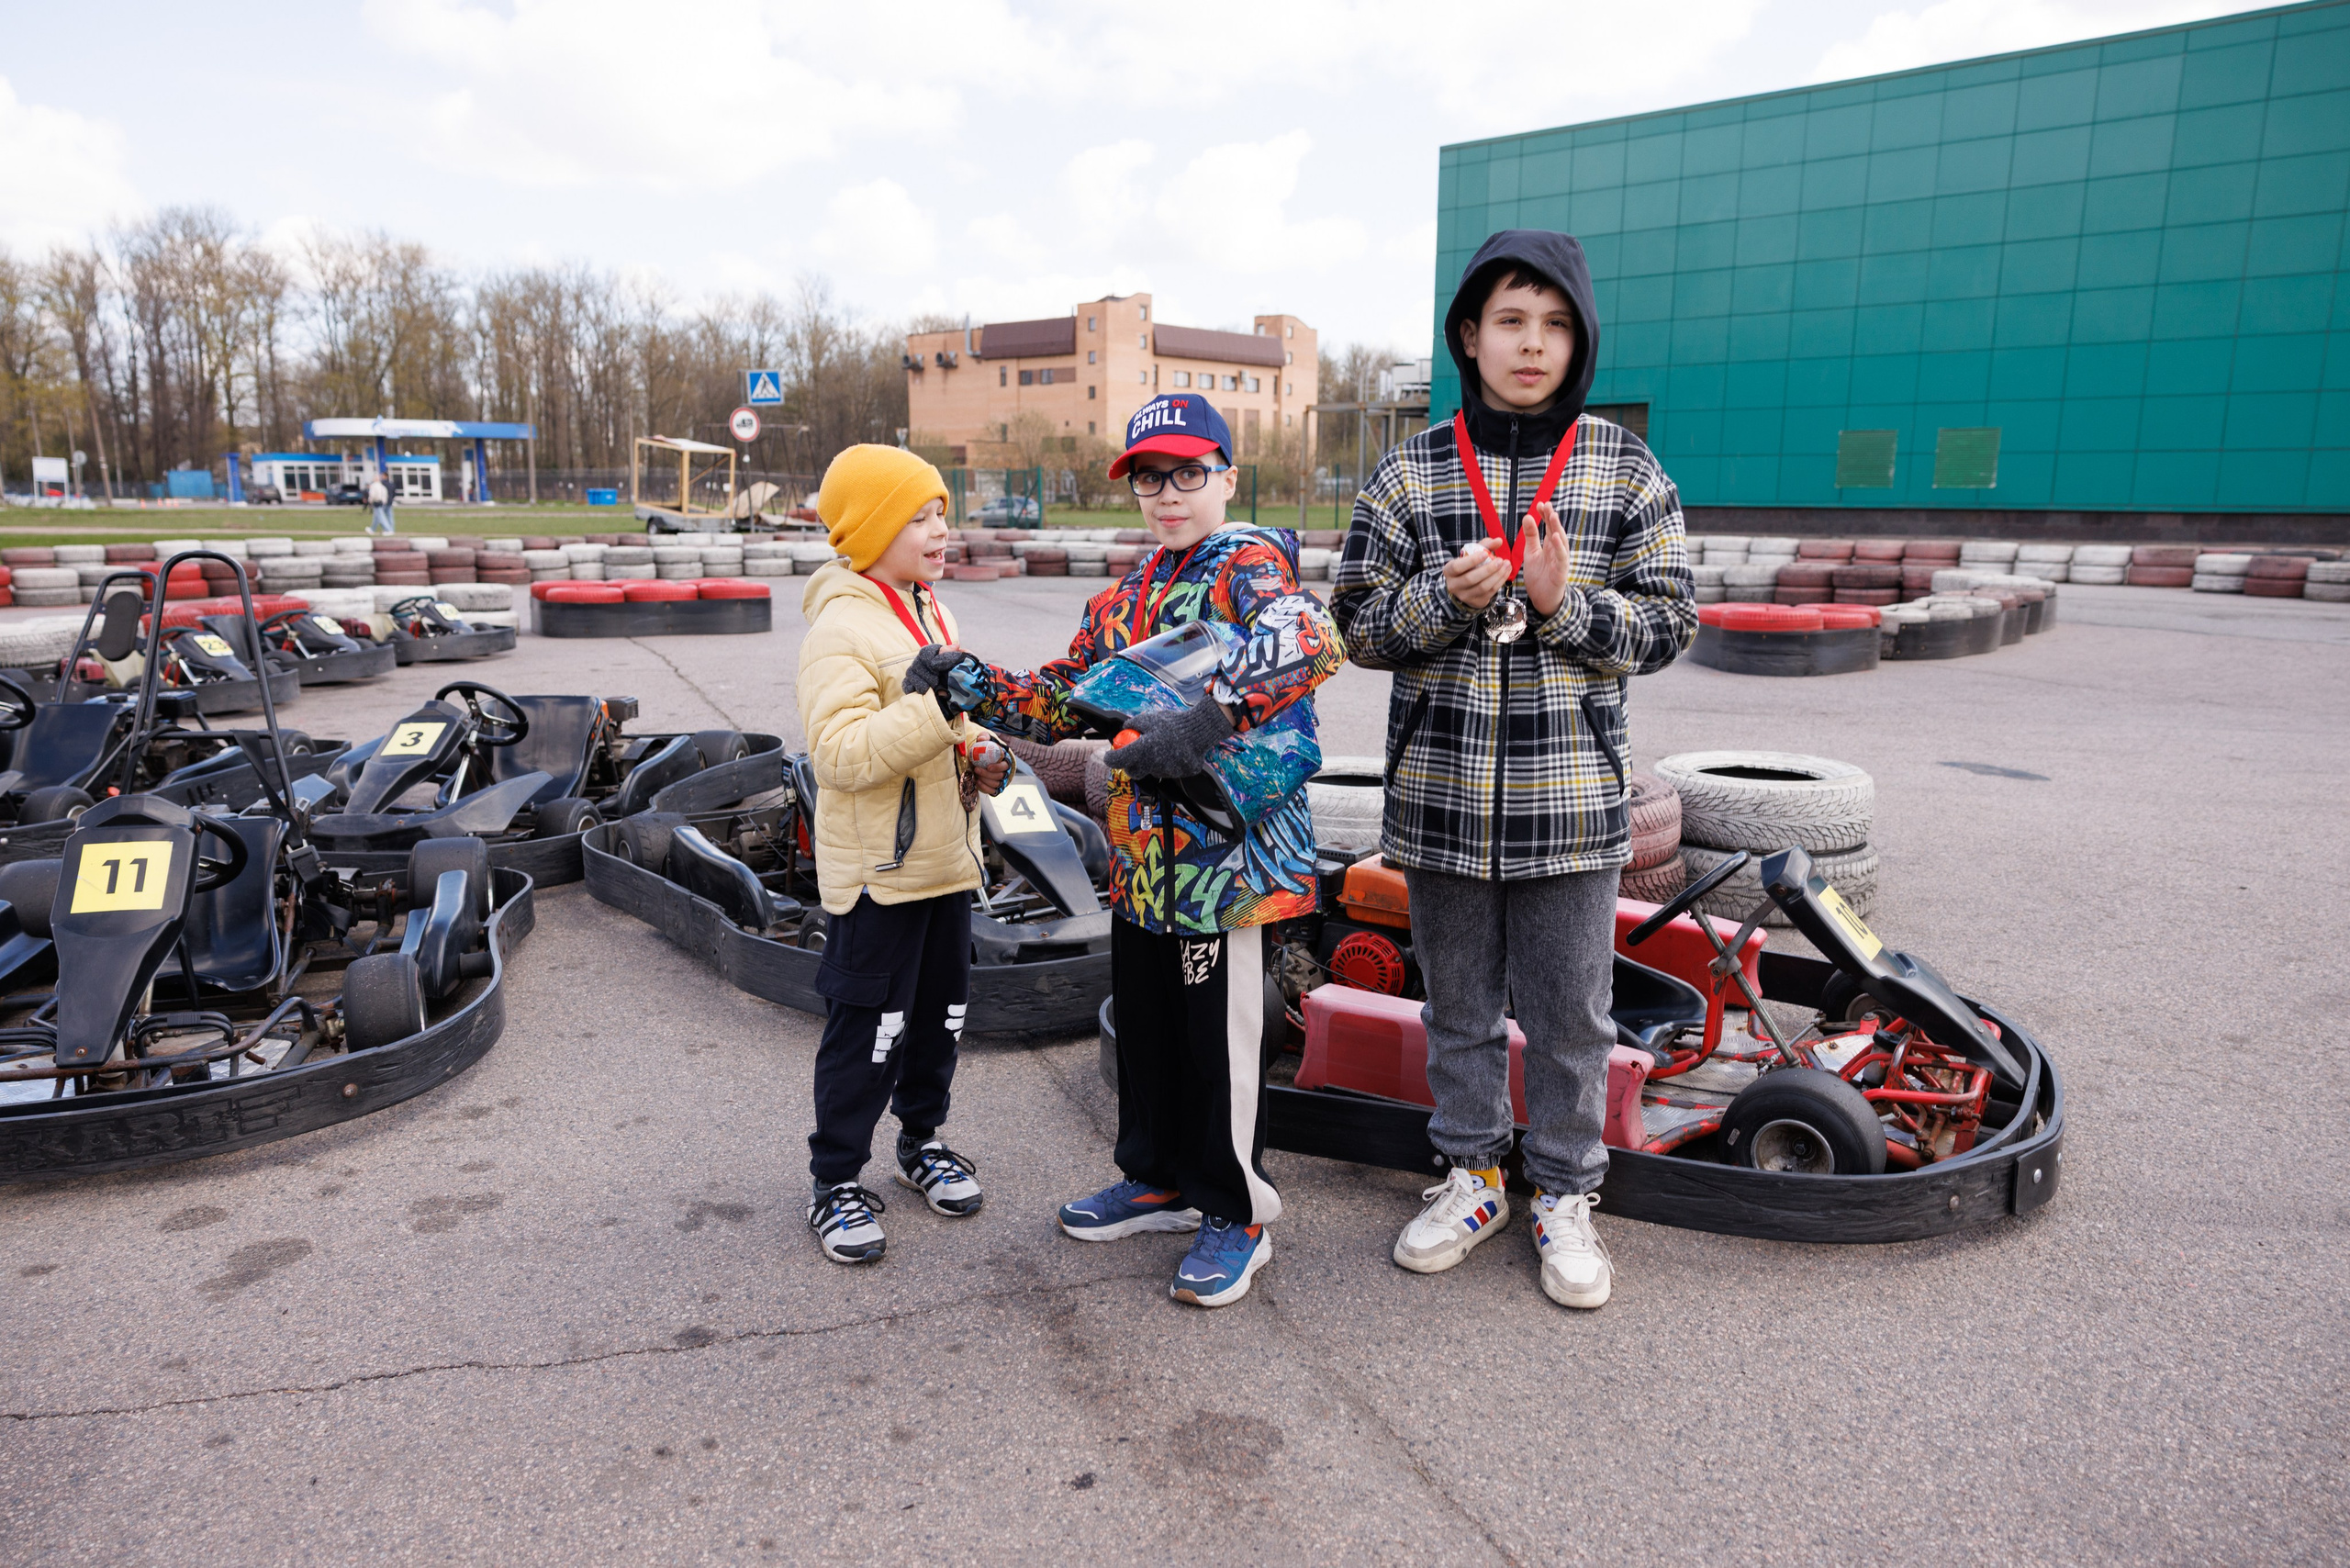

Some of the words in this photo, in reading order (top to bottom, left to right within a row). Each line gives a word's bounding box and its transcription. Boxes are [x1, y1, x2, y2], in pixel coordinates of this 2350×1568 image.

[1131, 408, 1187, 440] CHILL
[1133, 399, 1169, 424] ALWAYS
[1171, 398, 1189, 409] ON
[400, 731, 424, 747] 3
[1011, 796, 1035, 820] 4
[102, 857, 148, 894] 11
[1836, 902, 1868, 939] 10
